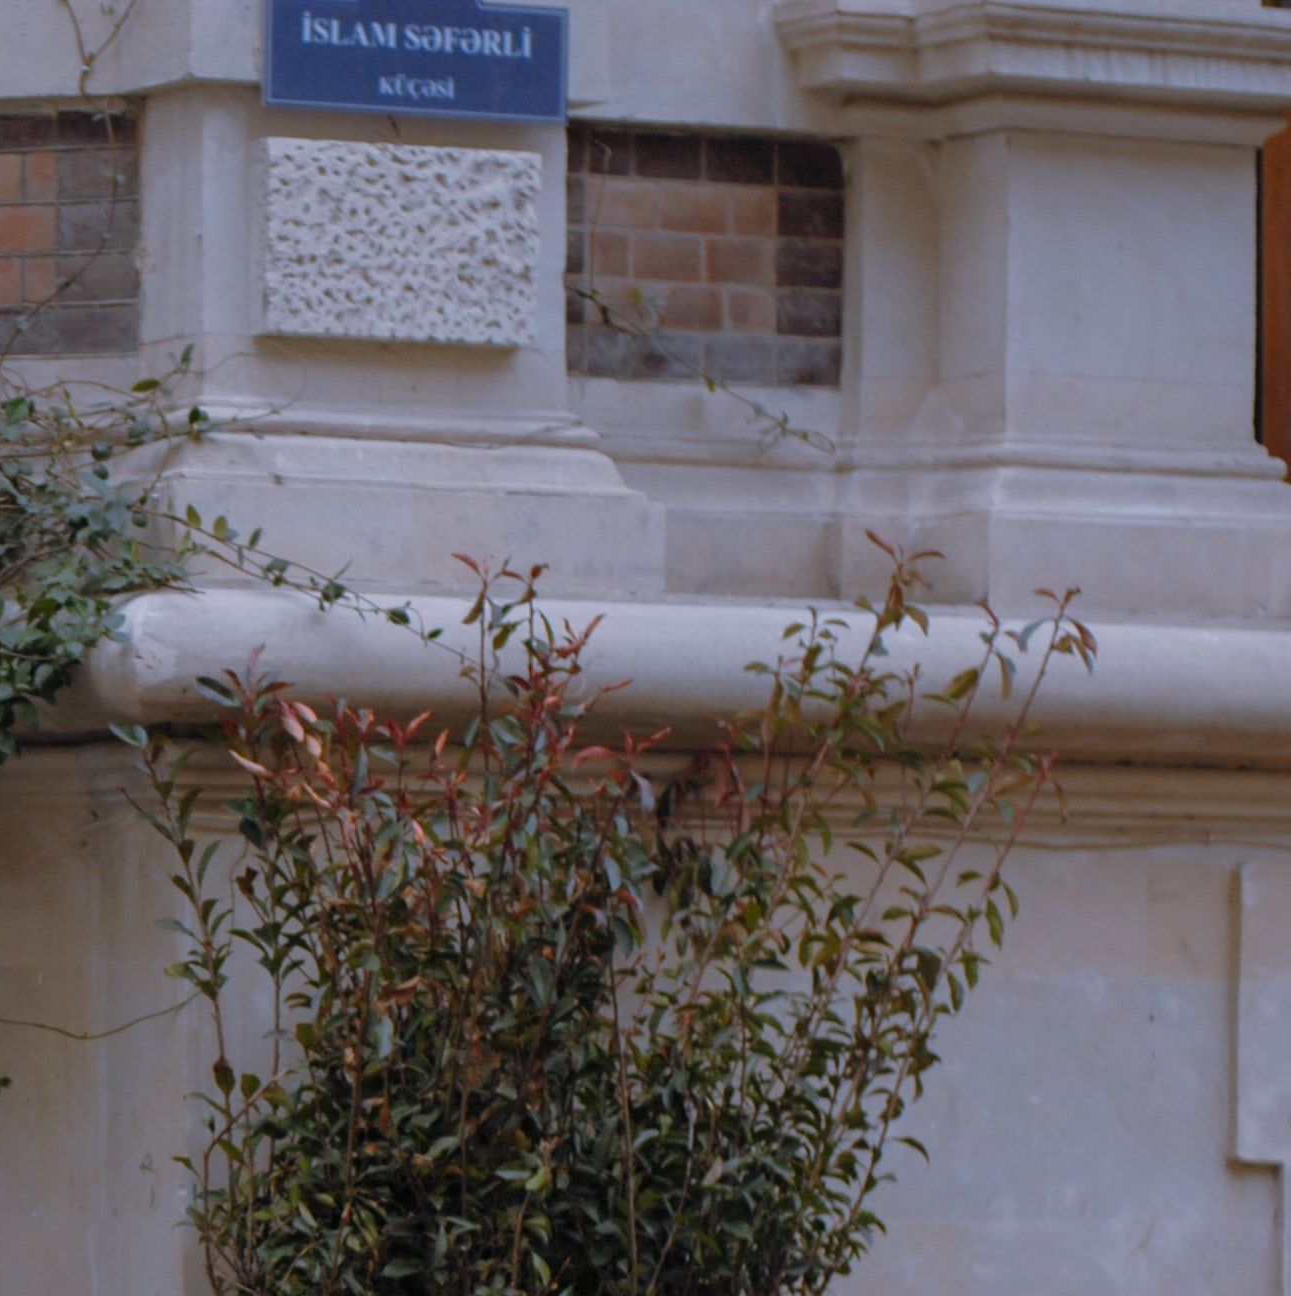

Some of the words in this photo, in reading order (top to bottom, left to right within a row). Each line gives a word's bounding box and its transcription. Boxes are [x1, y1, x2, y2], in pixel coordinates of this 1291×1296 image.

[302, 12, 398, 49] İSLAM
[403, 23, 532, 59] SƏFƏRLİ
[377, 73, 456, 99] KÜÇƏSİ
